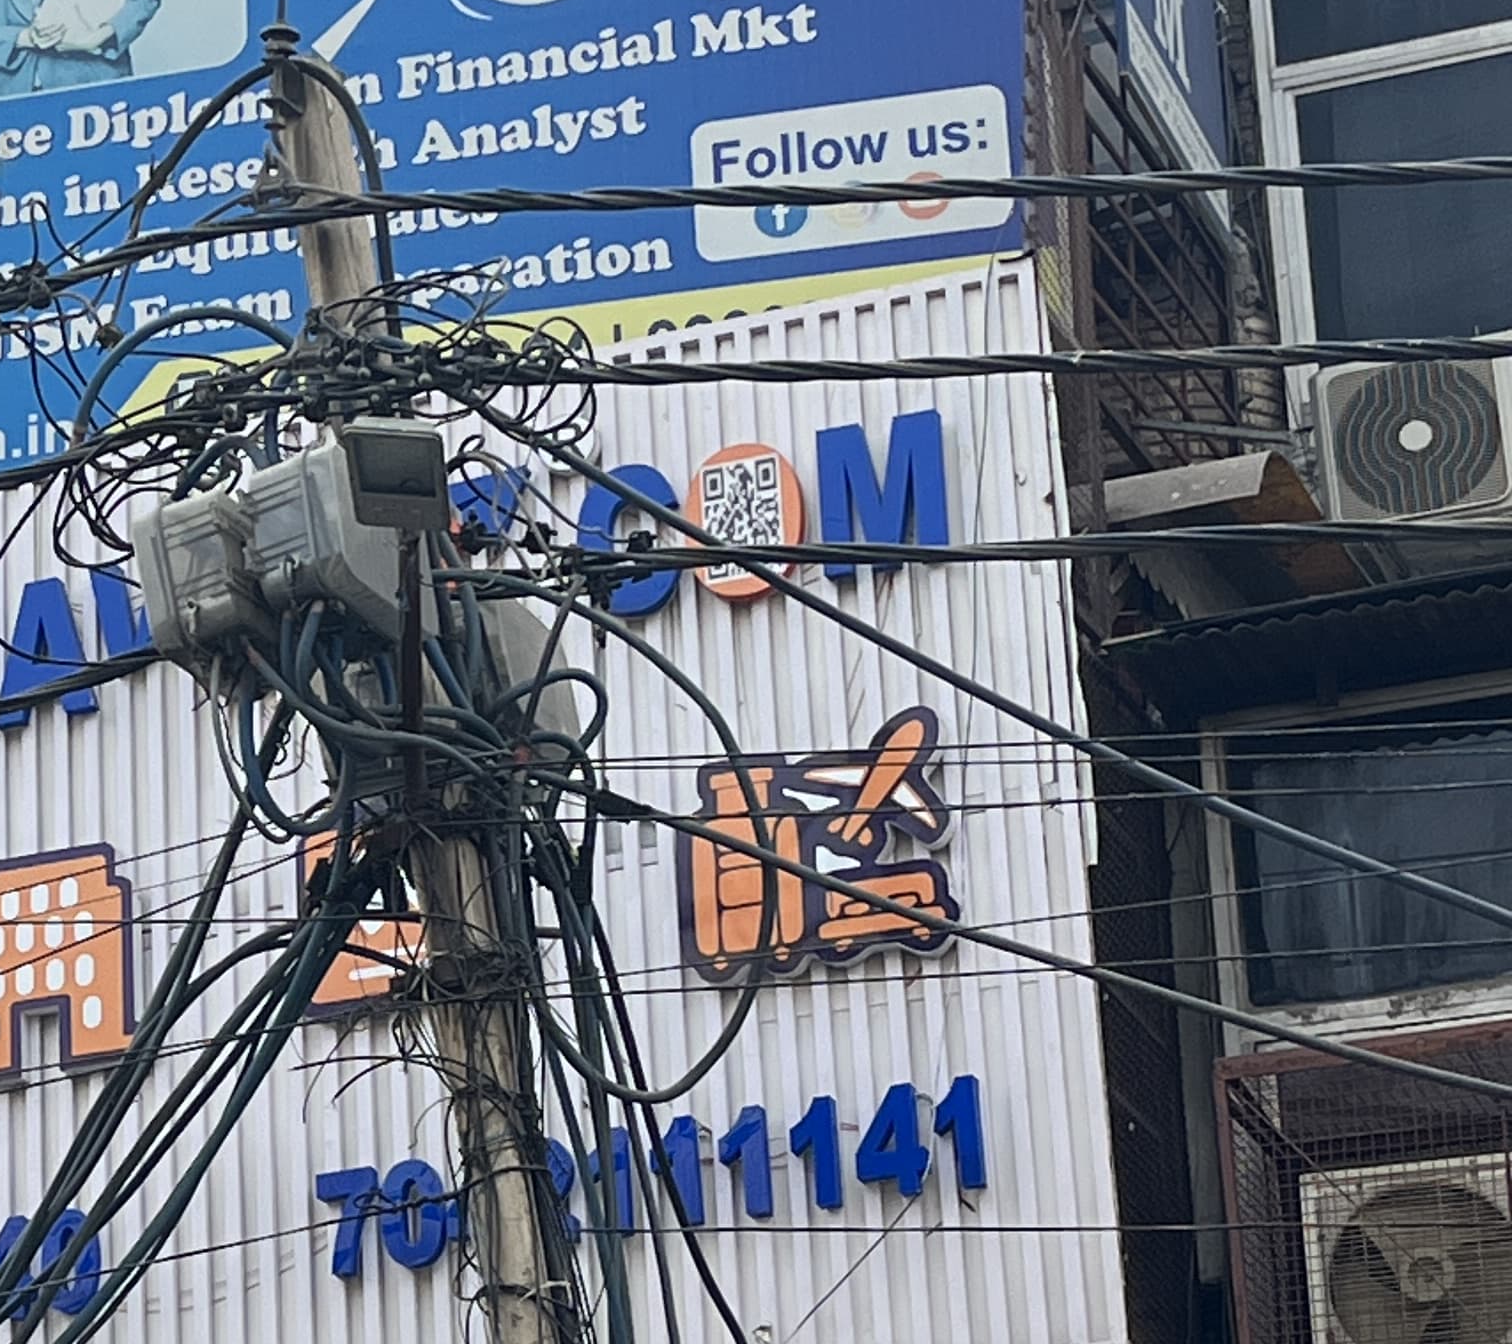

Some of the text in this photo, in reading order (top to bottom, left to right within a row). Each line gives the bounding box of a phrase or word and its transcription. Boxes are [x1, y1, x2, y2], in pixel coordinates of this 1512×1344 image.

[66, 85, 274, 150] Diplom
[397, 18, 676, 100] Financial
[691, 3, 818, 58] Mkt
[63, 174, 121, 217] in
[411, 96, 647, 165] Analyst
[711, 117, 988, 184] Follow us:
